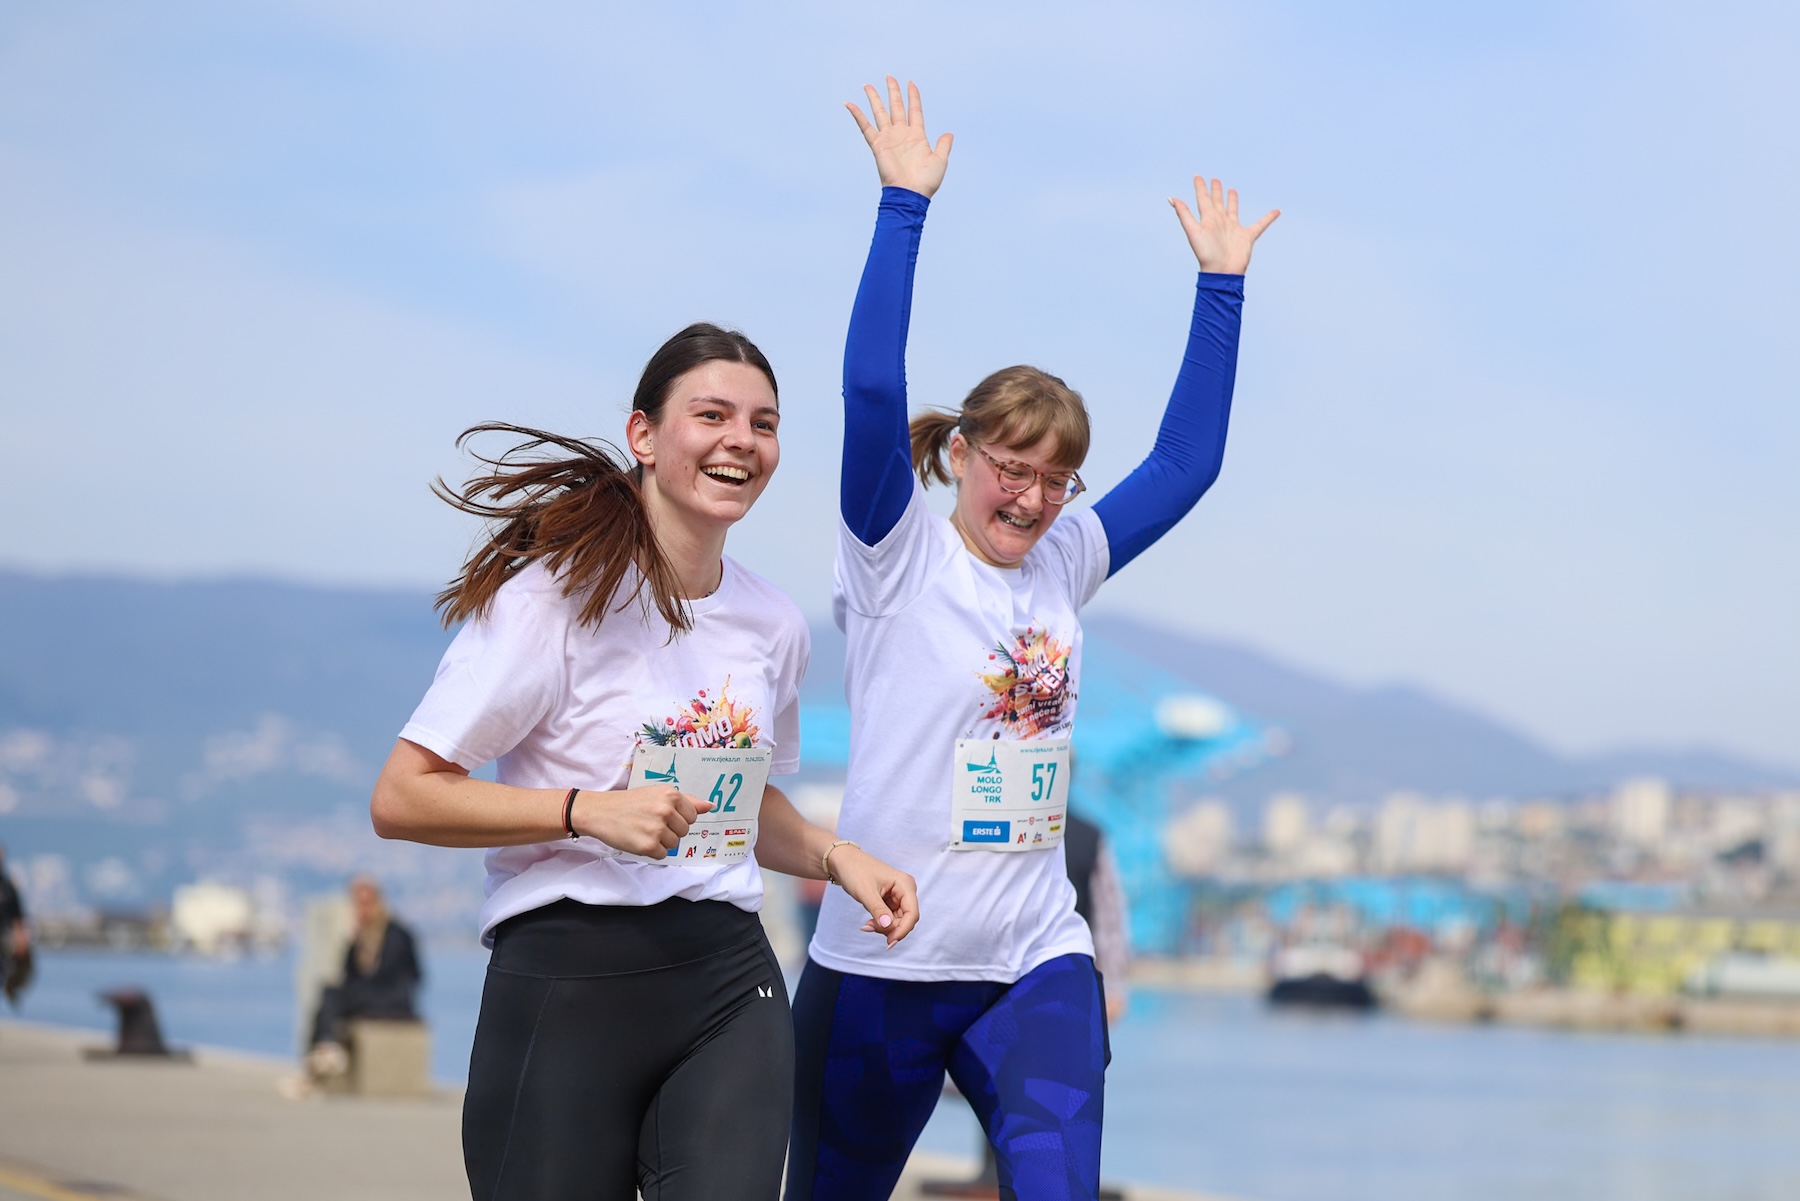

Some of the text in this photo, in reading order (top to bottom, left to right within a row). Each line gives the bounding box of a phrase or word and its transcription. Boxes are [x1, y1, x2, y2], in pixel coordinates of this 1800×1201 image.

[668, 716, 733, 748] OMO
[977, 776, 1002, 784] MOLO
[1031, 762, 1057, 801] 57
[708, 772, 743, 814] 62
[971, 785, 1002, 794] LONGO
[984, 795, 1001, 803] TRK
[972, 827, 994, 836] ERSTE
[1017, 832, 1027, 844] A1
[685, 846, 697, 858] A1
